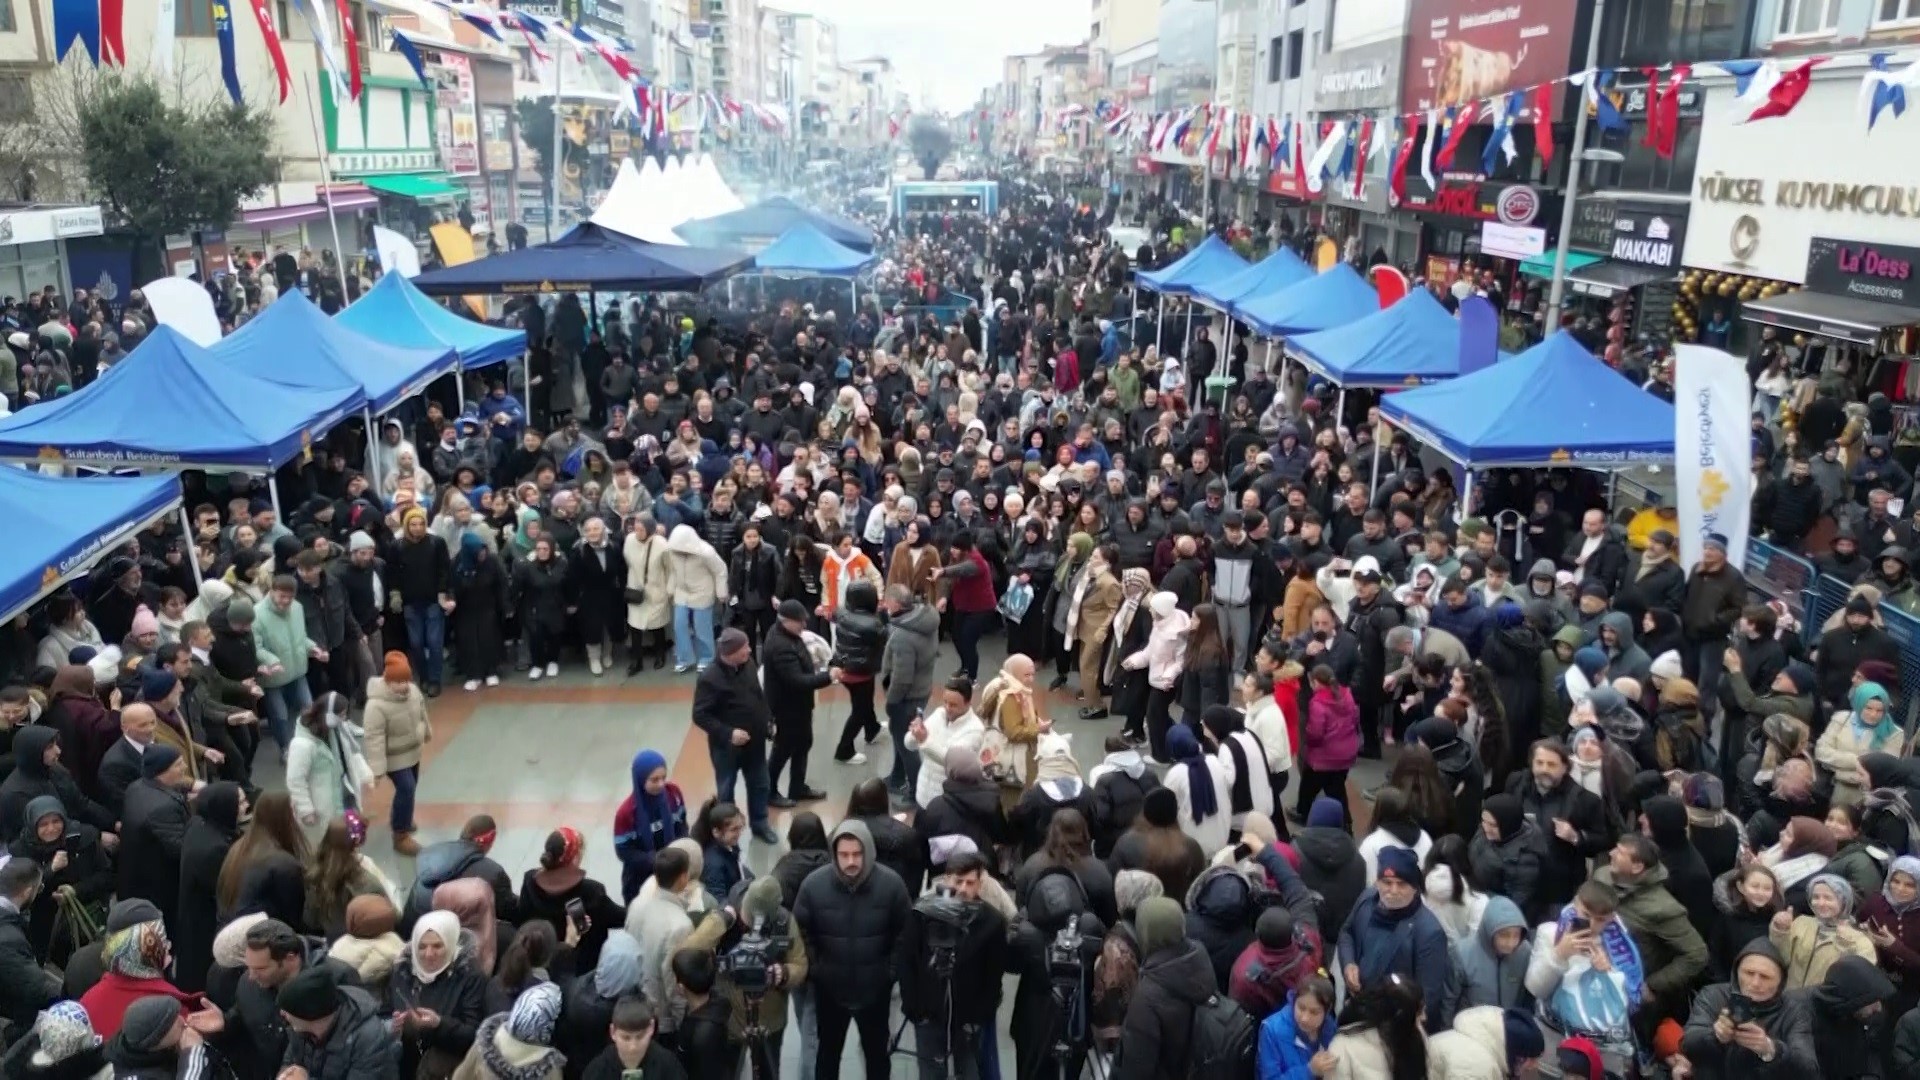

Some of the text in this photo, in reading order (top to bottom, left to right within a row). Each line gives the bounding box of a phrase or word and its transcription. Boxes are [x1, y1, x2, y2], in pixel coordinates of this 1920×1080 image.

[1699, 171, 1764, 206] YÜKSEL
[1611, 237, 1673, 267] AYAKKABI
[1838, 247, 1911, 280] La'Dess
[1848, 279, 1904, 299] Accessories
[65, 449, 123, 461] Sultanbeyli
[60, 538, 101, 576] Sultanbeyli
